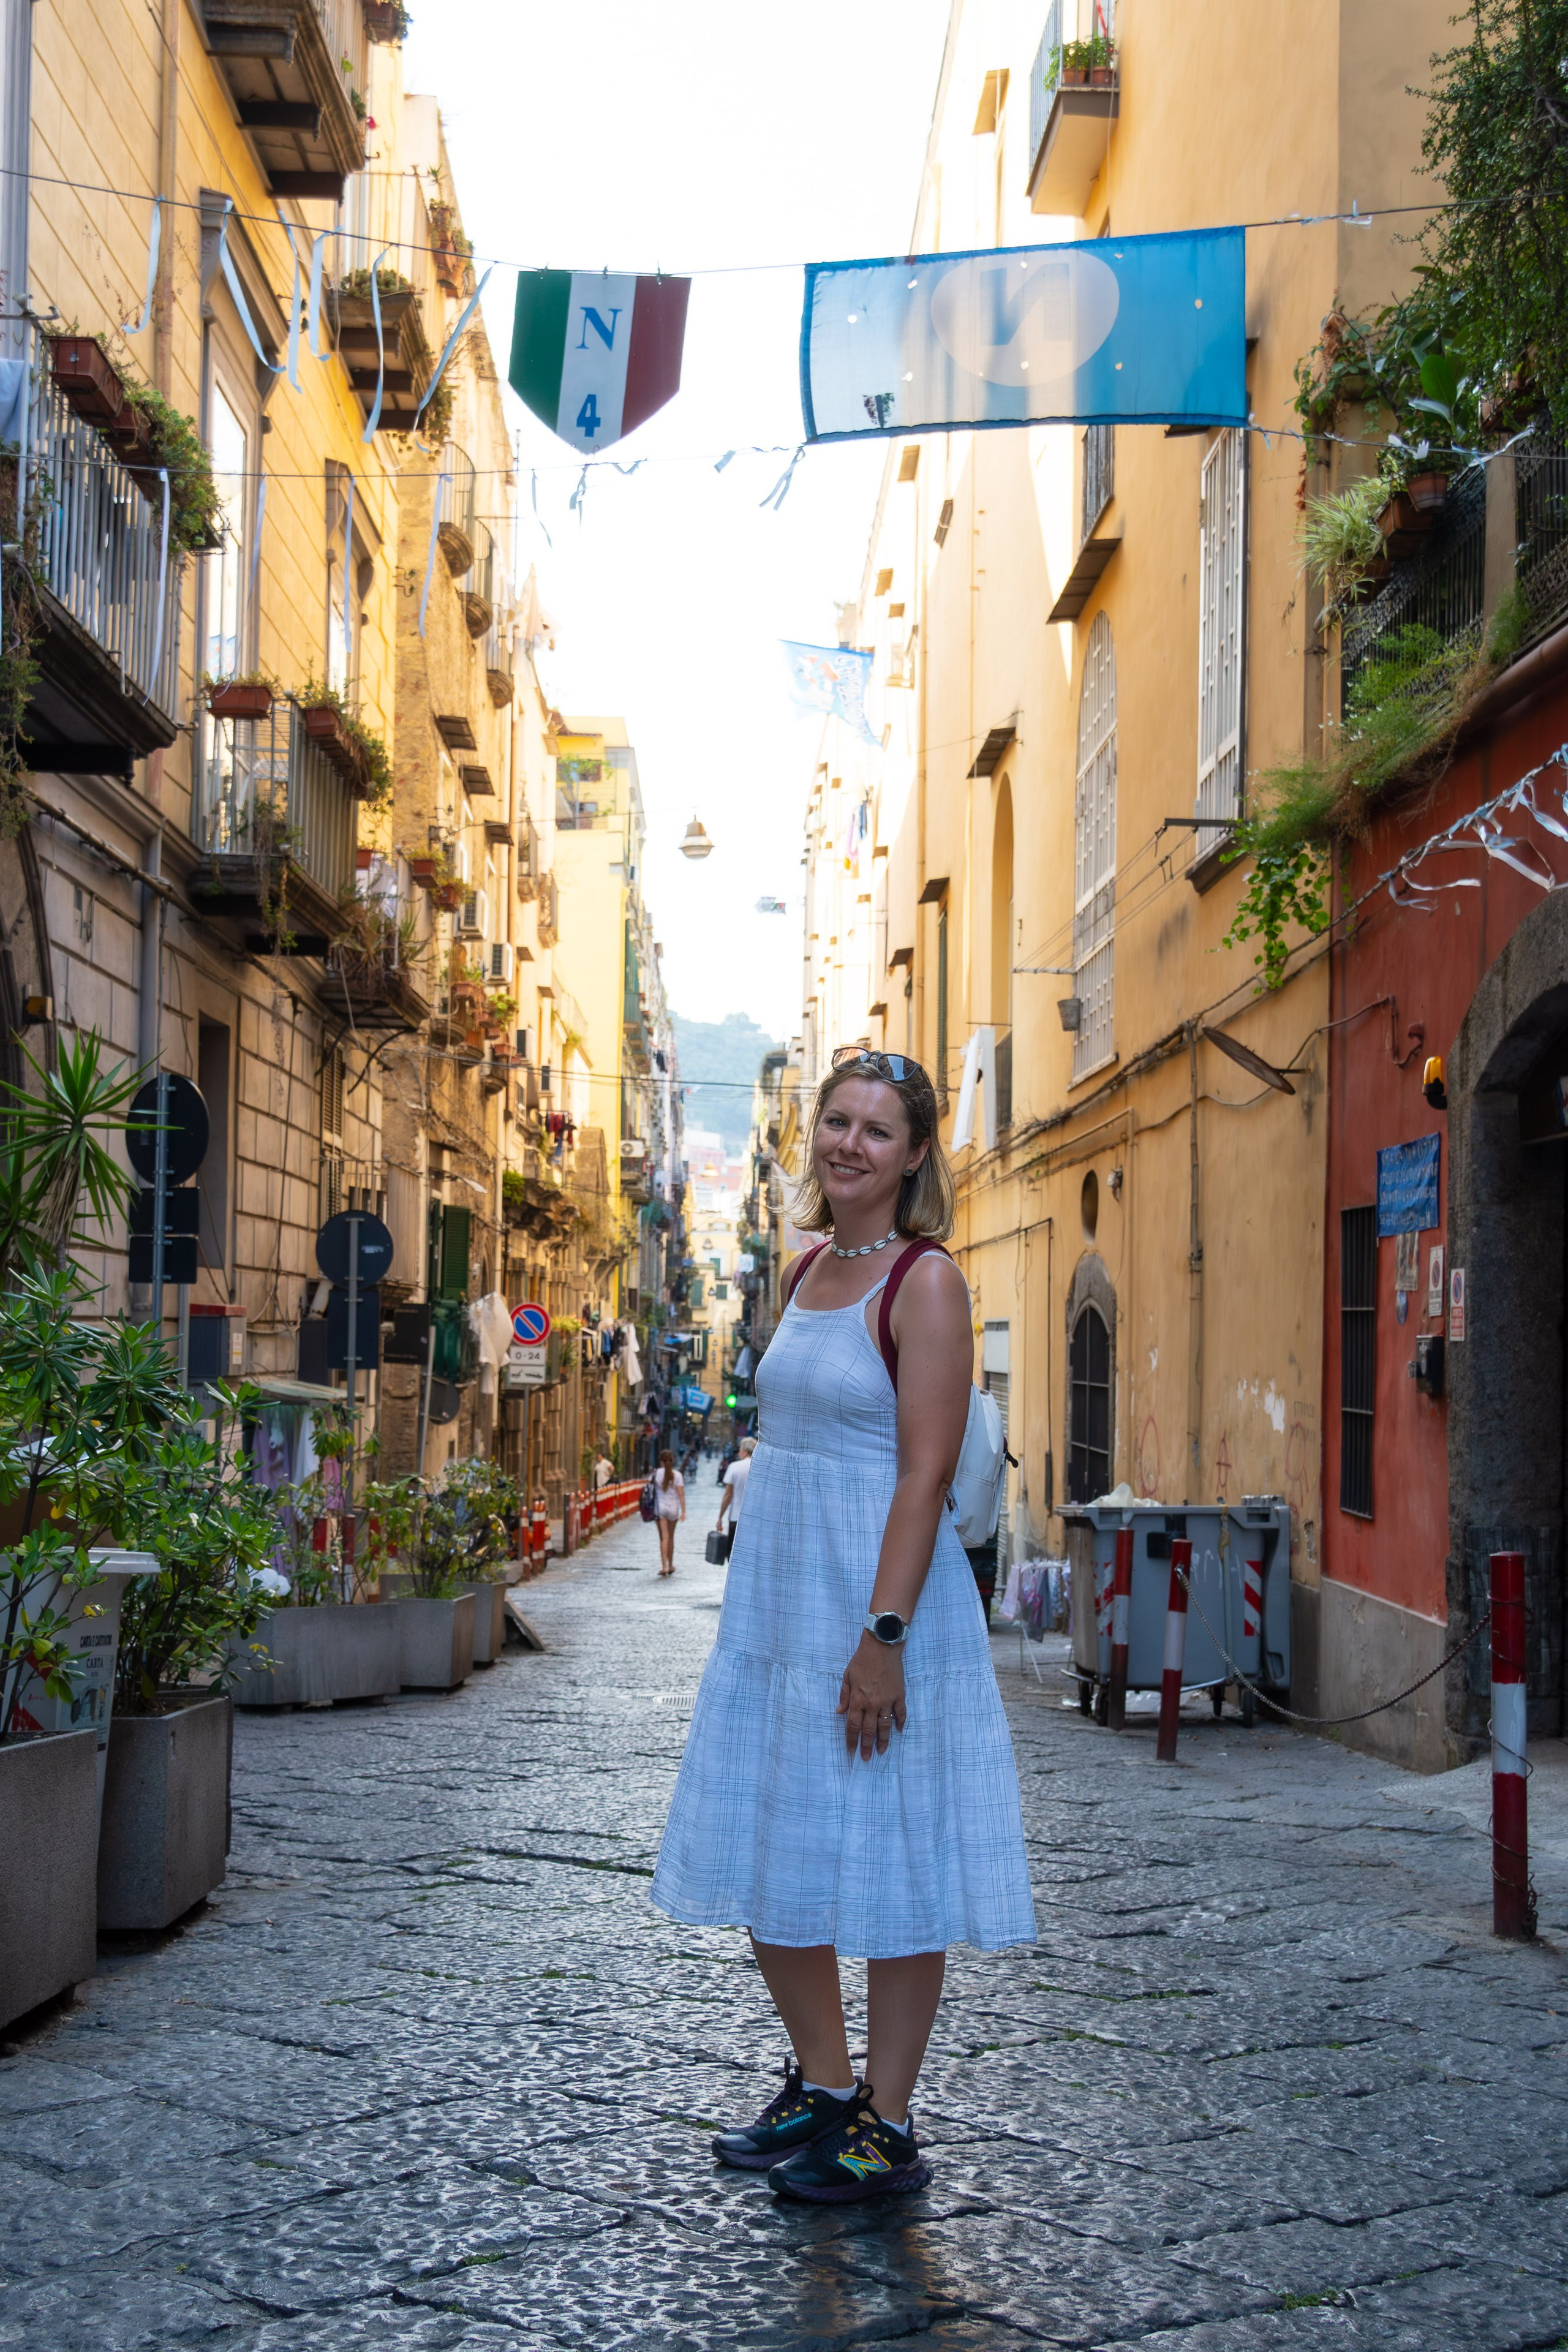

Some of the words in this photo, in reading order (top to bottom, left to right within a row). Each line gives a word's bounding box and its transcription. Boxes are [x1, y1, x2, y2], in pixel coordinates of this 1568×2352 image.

[575, 306, 623, 352] N
[576, 393, 601, 438] 4
[86, 1657, 104, 1668] CARTA
[776, 2122, 788, 2131] new
[788, 2112, 812, 2126] balance
